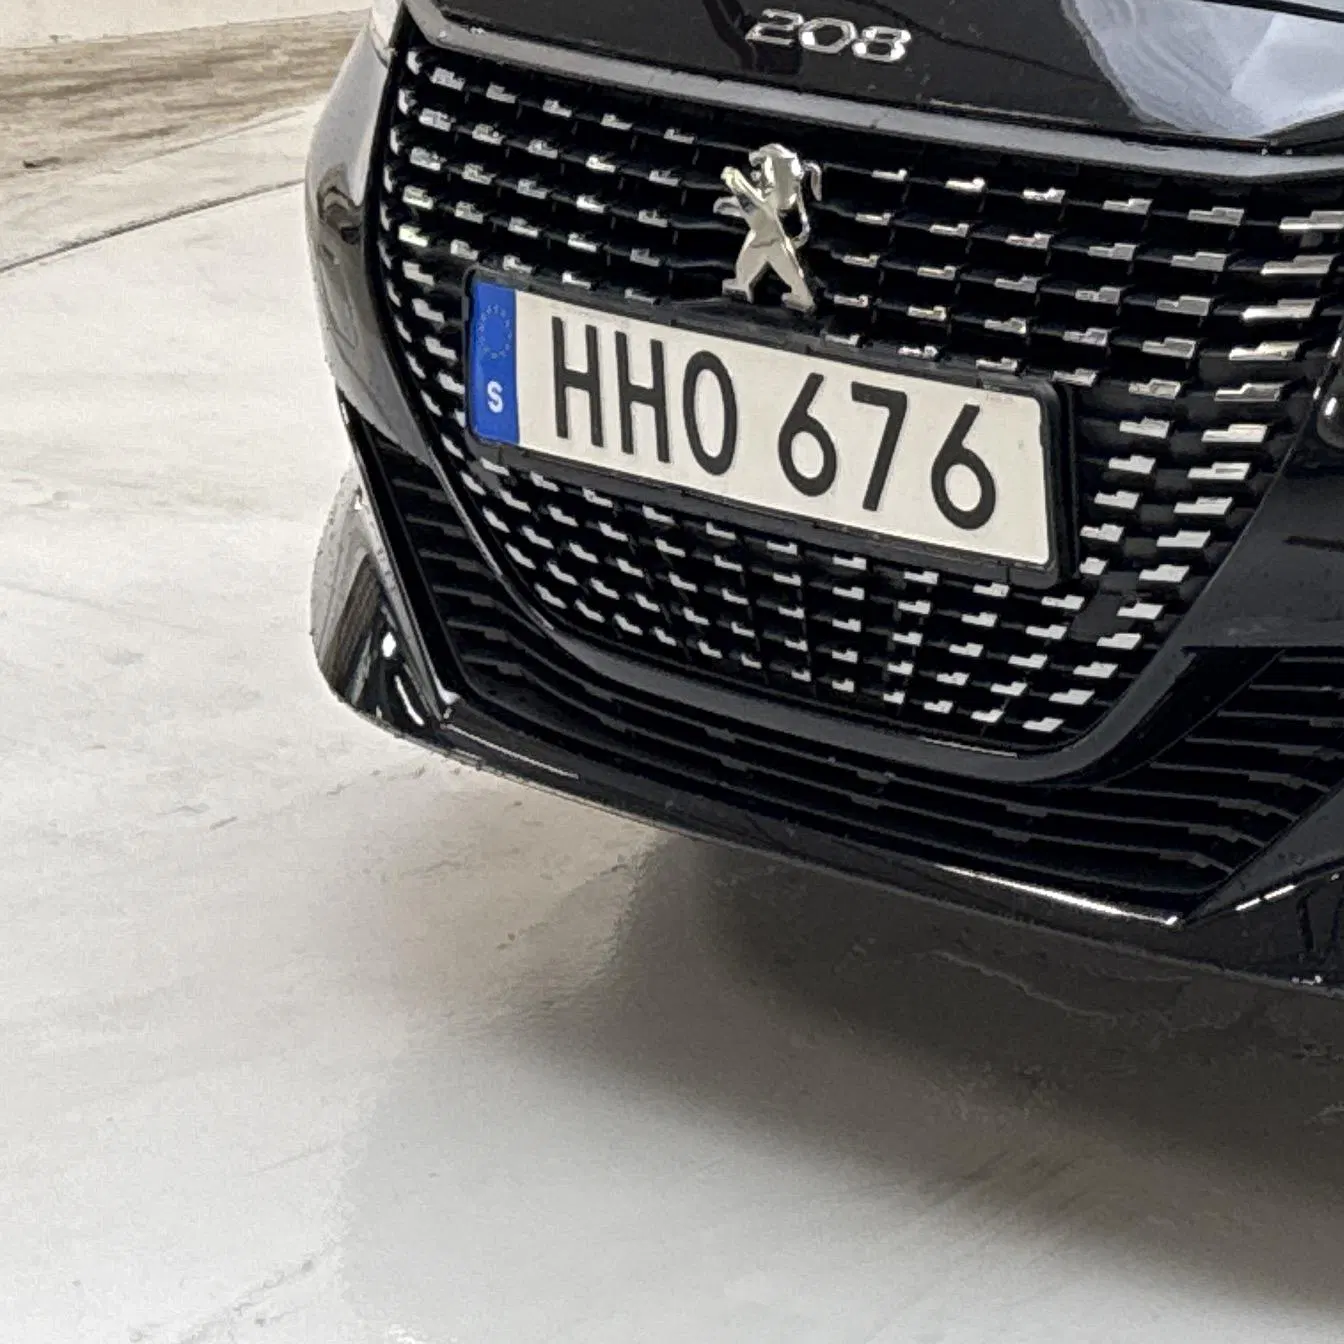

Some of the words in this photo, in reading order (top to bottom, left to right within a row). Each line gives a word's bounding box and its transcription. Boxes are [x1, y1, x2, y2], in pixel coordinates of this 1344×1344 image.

[745, 8, 911, 63] 208
[486, 380, 505, 414] S
[552, 316, 737, 476] HHO
[778, 372, 996, 530] 676
